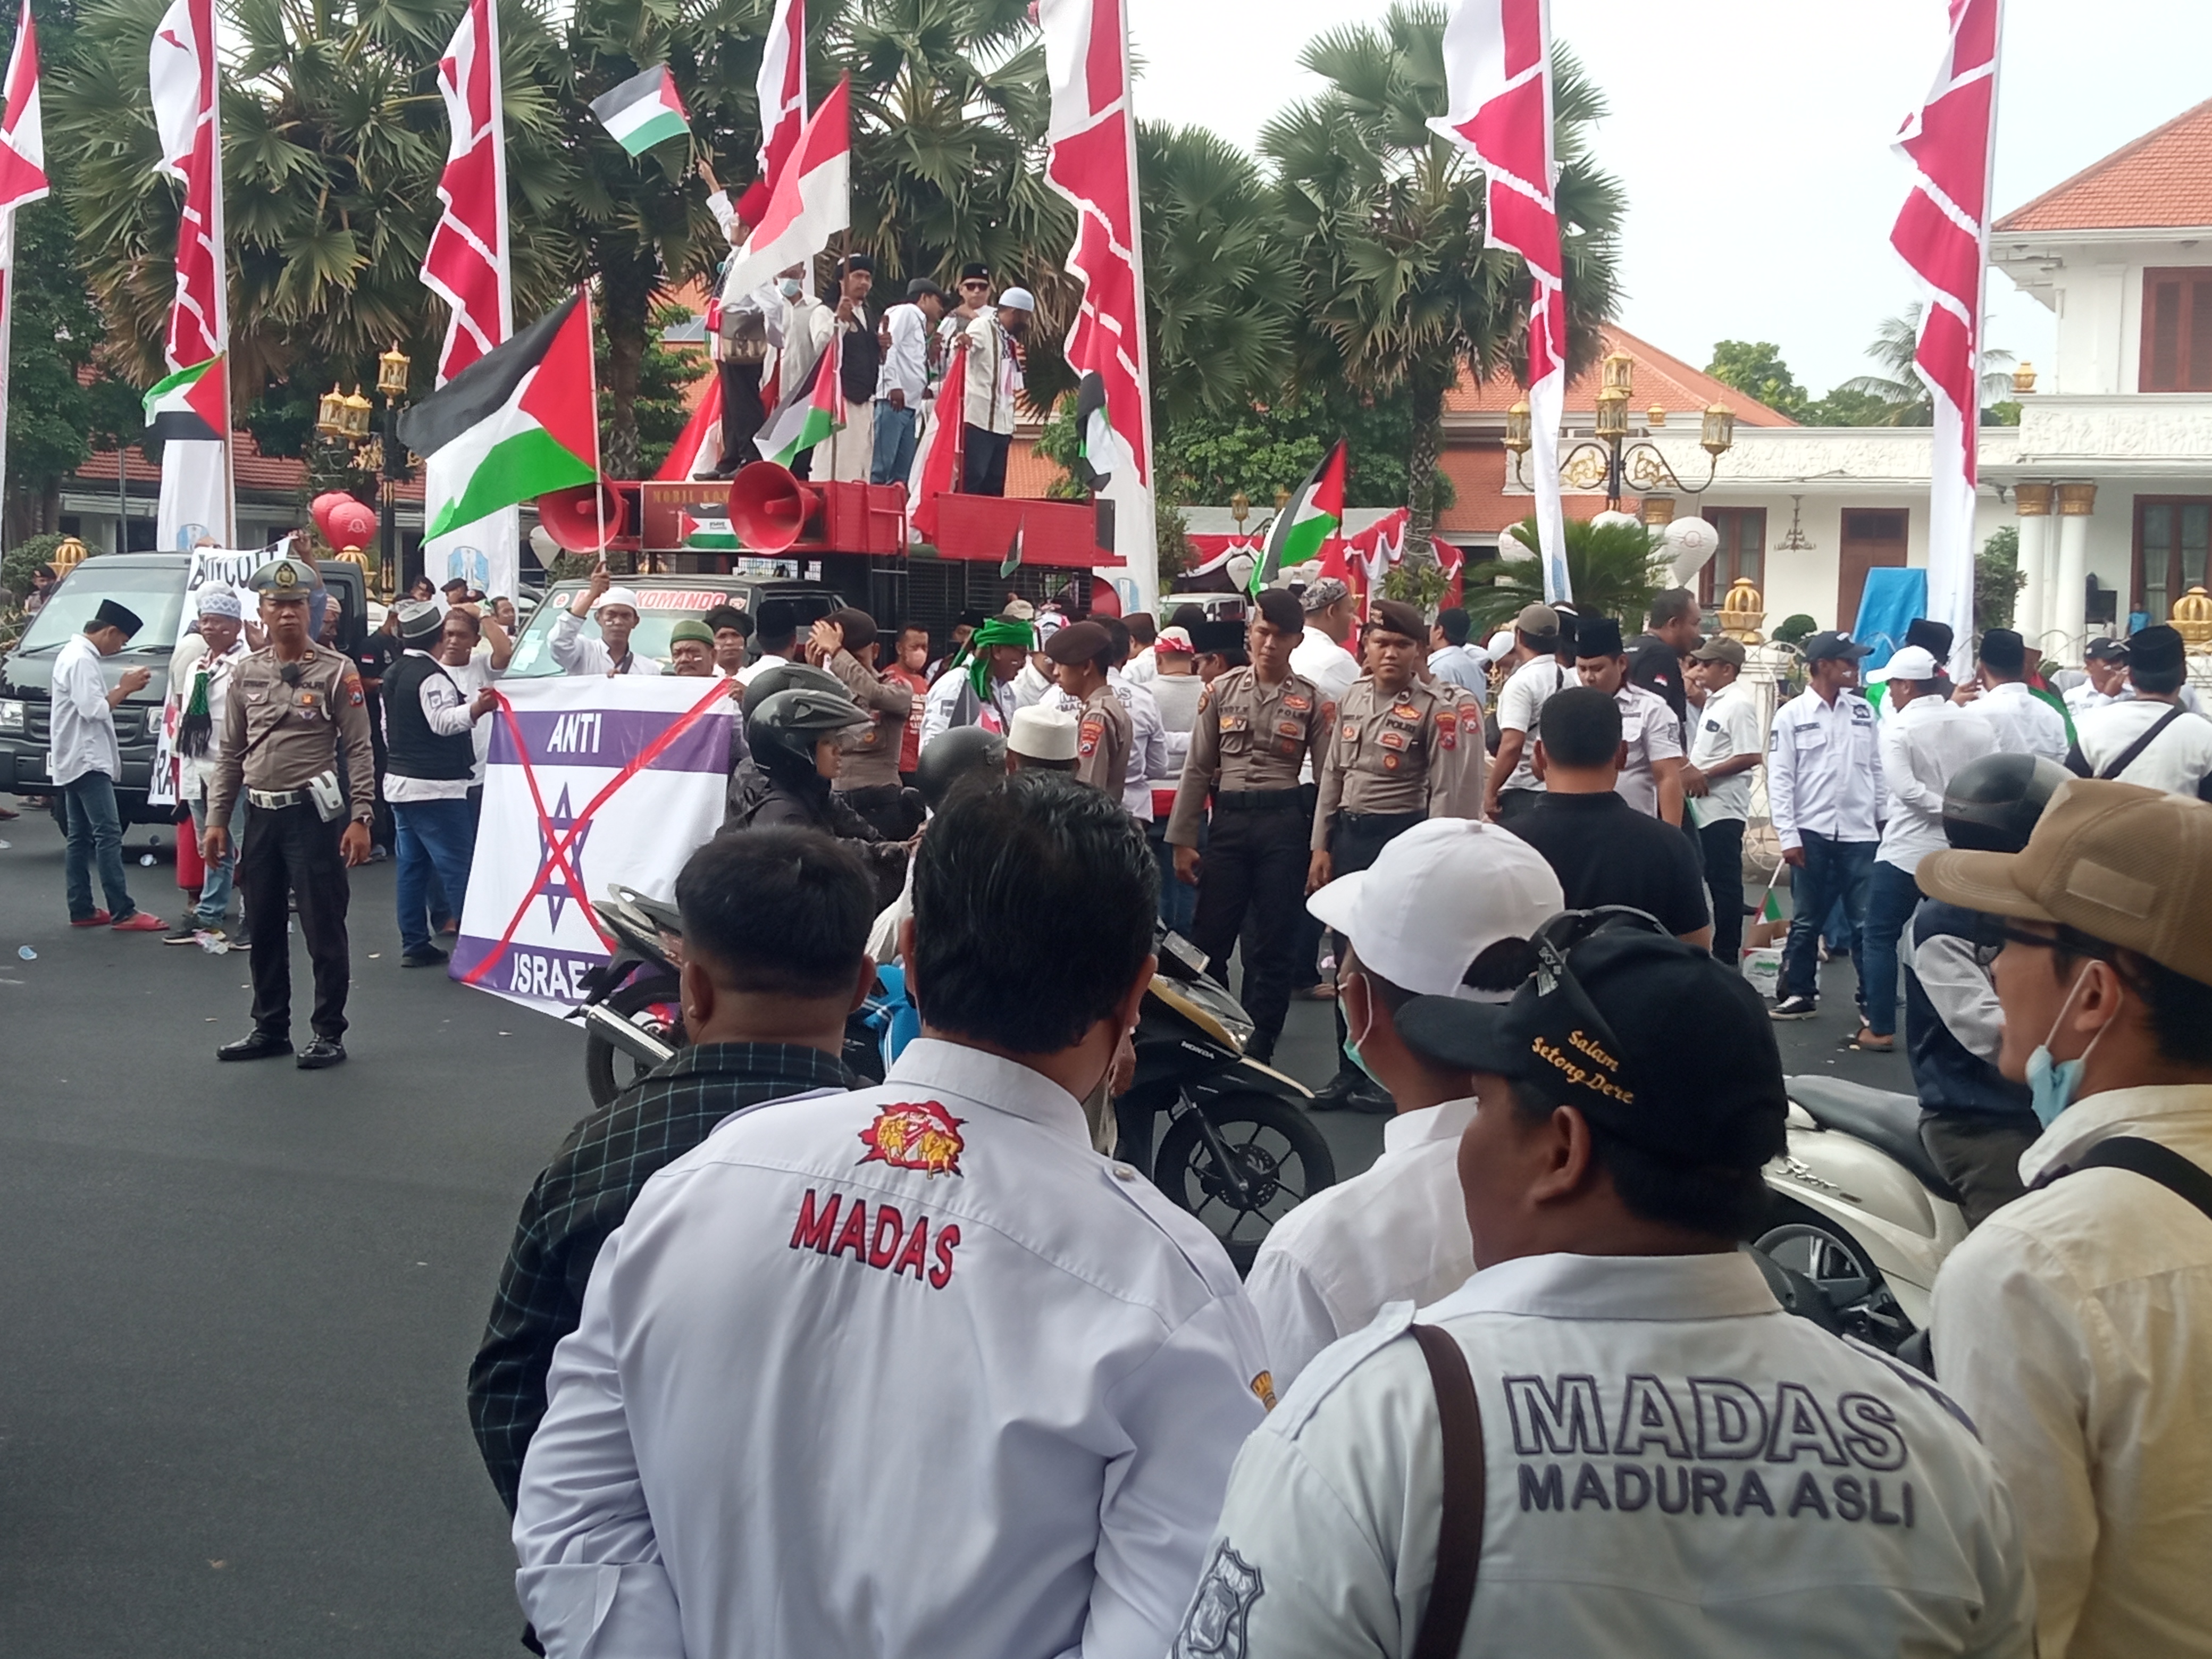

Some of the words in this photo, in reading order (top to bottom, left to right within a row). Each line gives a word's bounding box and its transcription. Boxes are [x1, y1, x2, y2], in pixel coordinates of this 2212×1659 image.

[636, 591, 727, 611] KOMANDO
[546, 713, 602, 753] ANTI
[509, 952, 594, 999] ISRAE
[1181, 1041, 1215, 1059] HONDA
[1532, 1036, 1586, 1083] Setong
[1568, 1030, 1619, 1072] Salam
[789, 1188, 961, 1290] MADAS
[1502, 1373, 1907, 1471] MADAS
[1518, 1462, 1775, 1517] MADURA
[1788, 1471, 1913, 1529] ASLI
